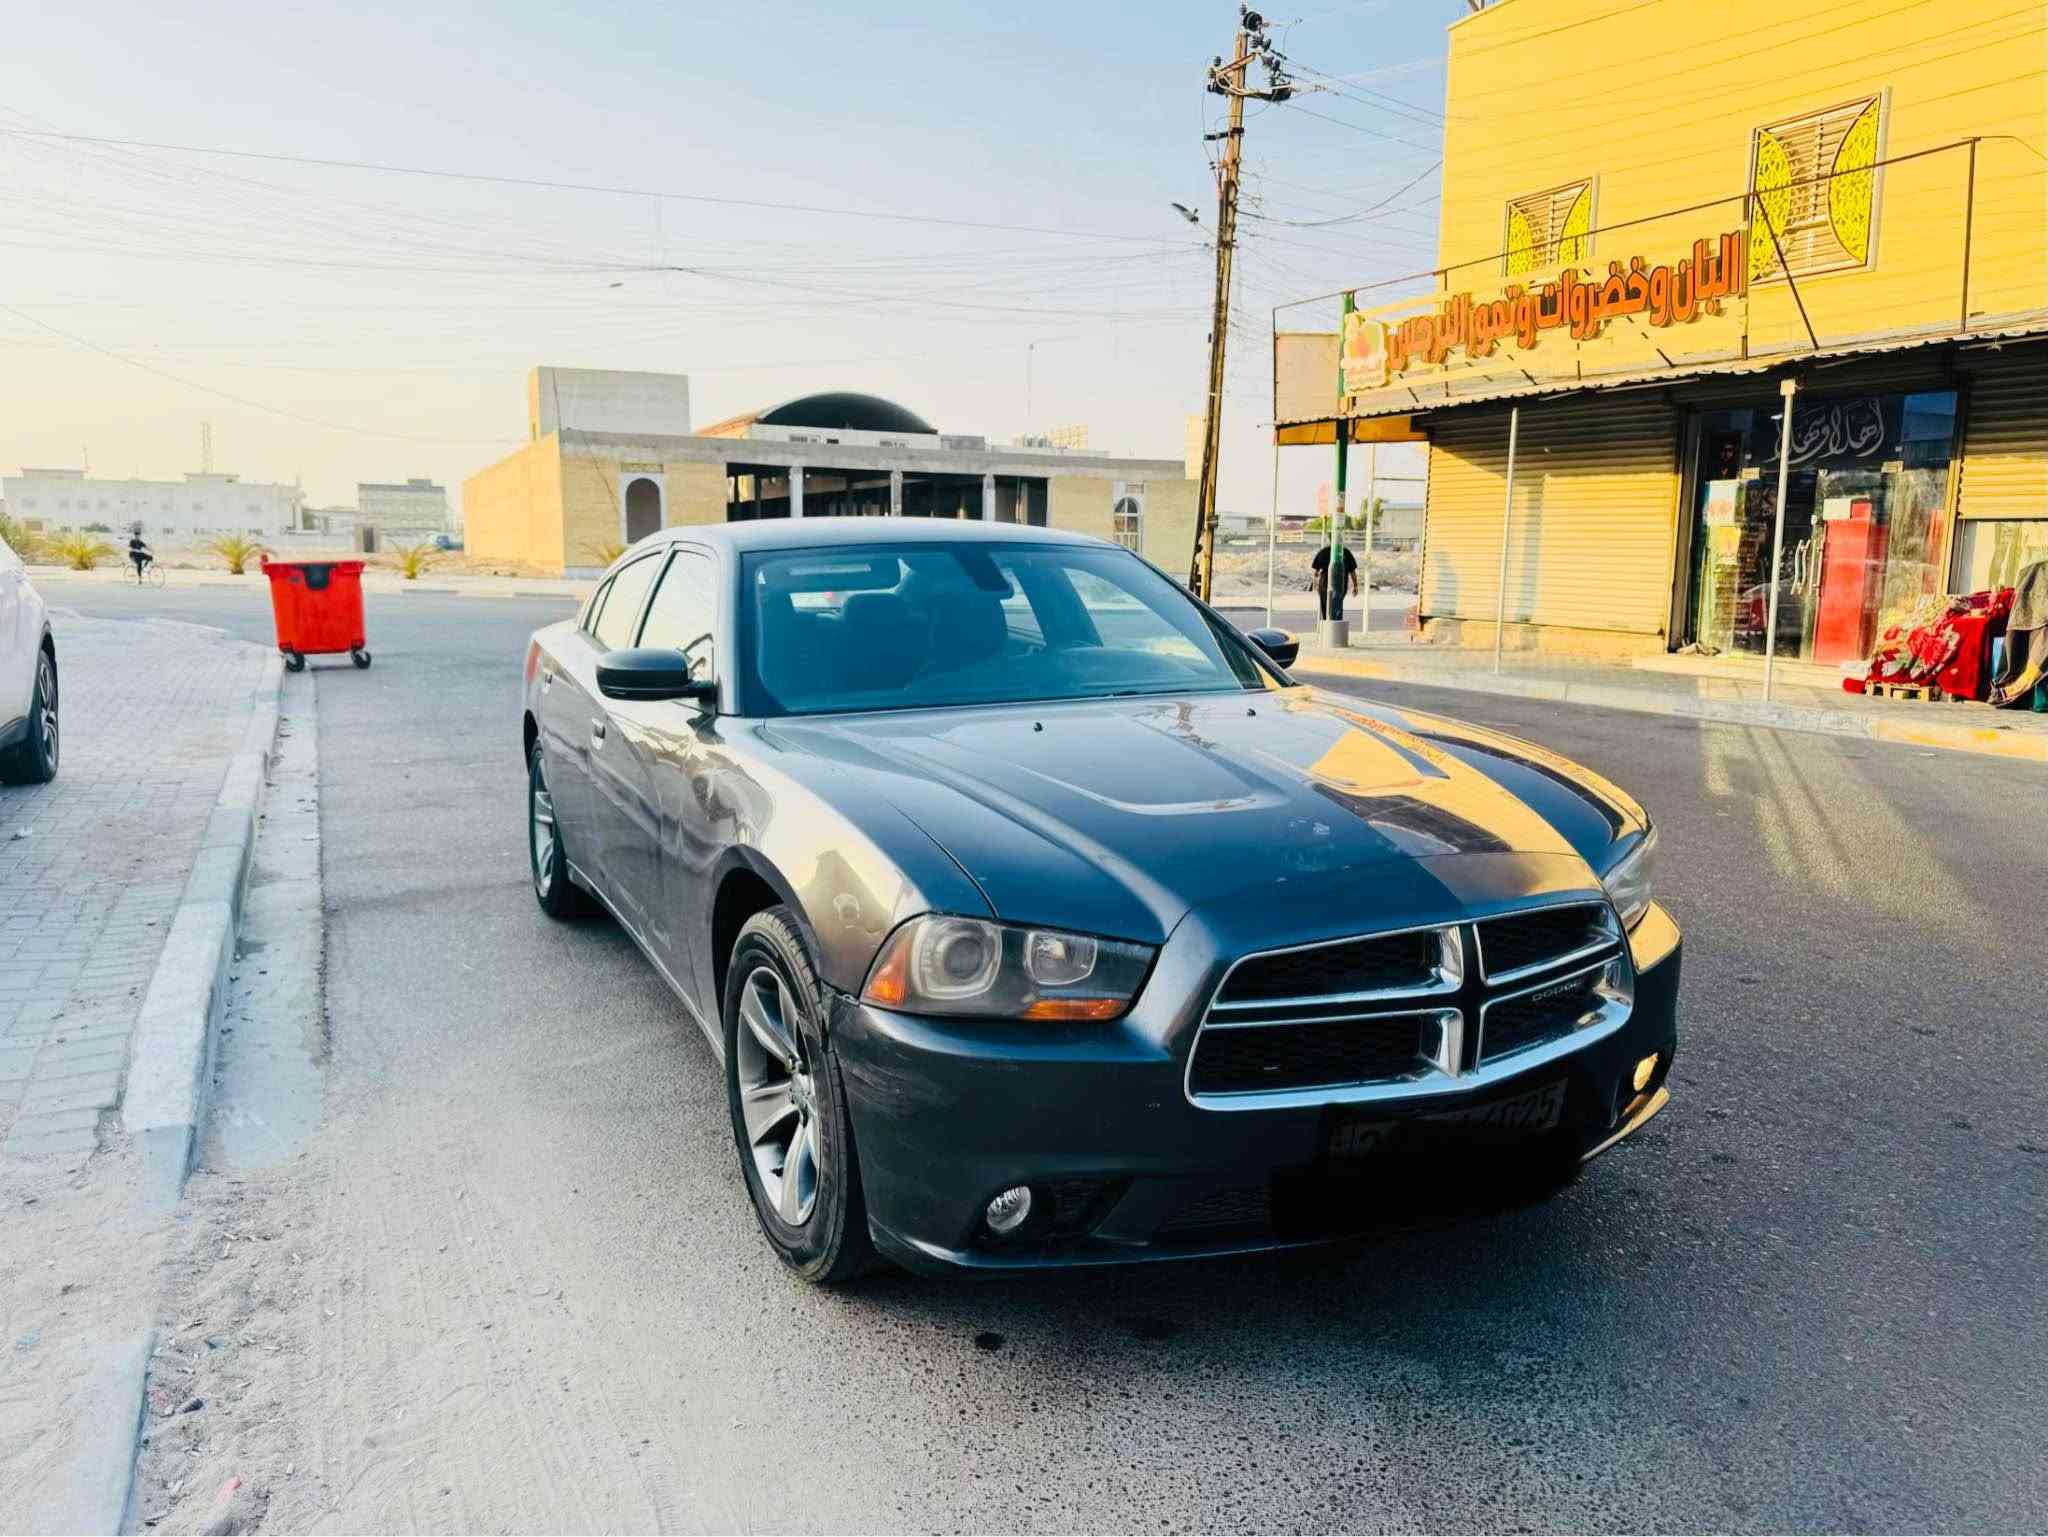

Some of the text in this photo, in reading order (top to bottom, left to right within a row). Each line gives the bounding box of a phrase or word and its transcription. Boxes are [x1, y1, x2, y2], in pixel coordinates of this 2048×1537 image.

[1536, 256, 1669, 341] وخضروات
[1671, 230, 1741, 322] البان
[1466, 284, 1535, 358] وتمور
